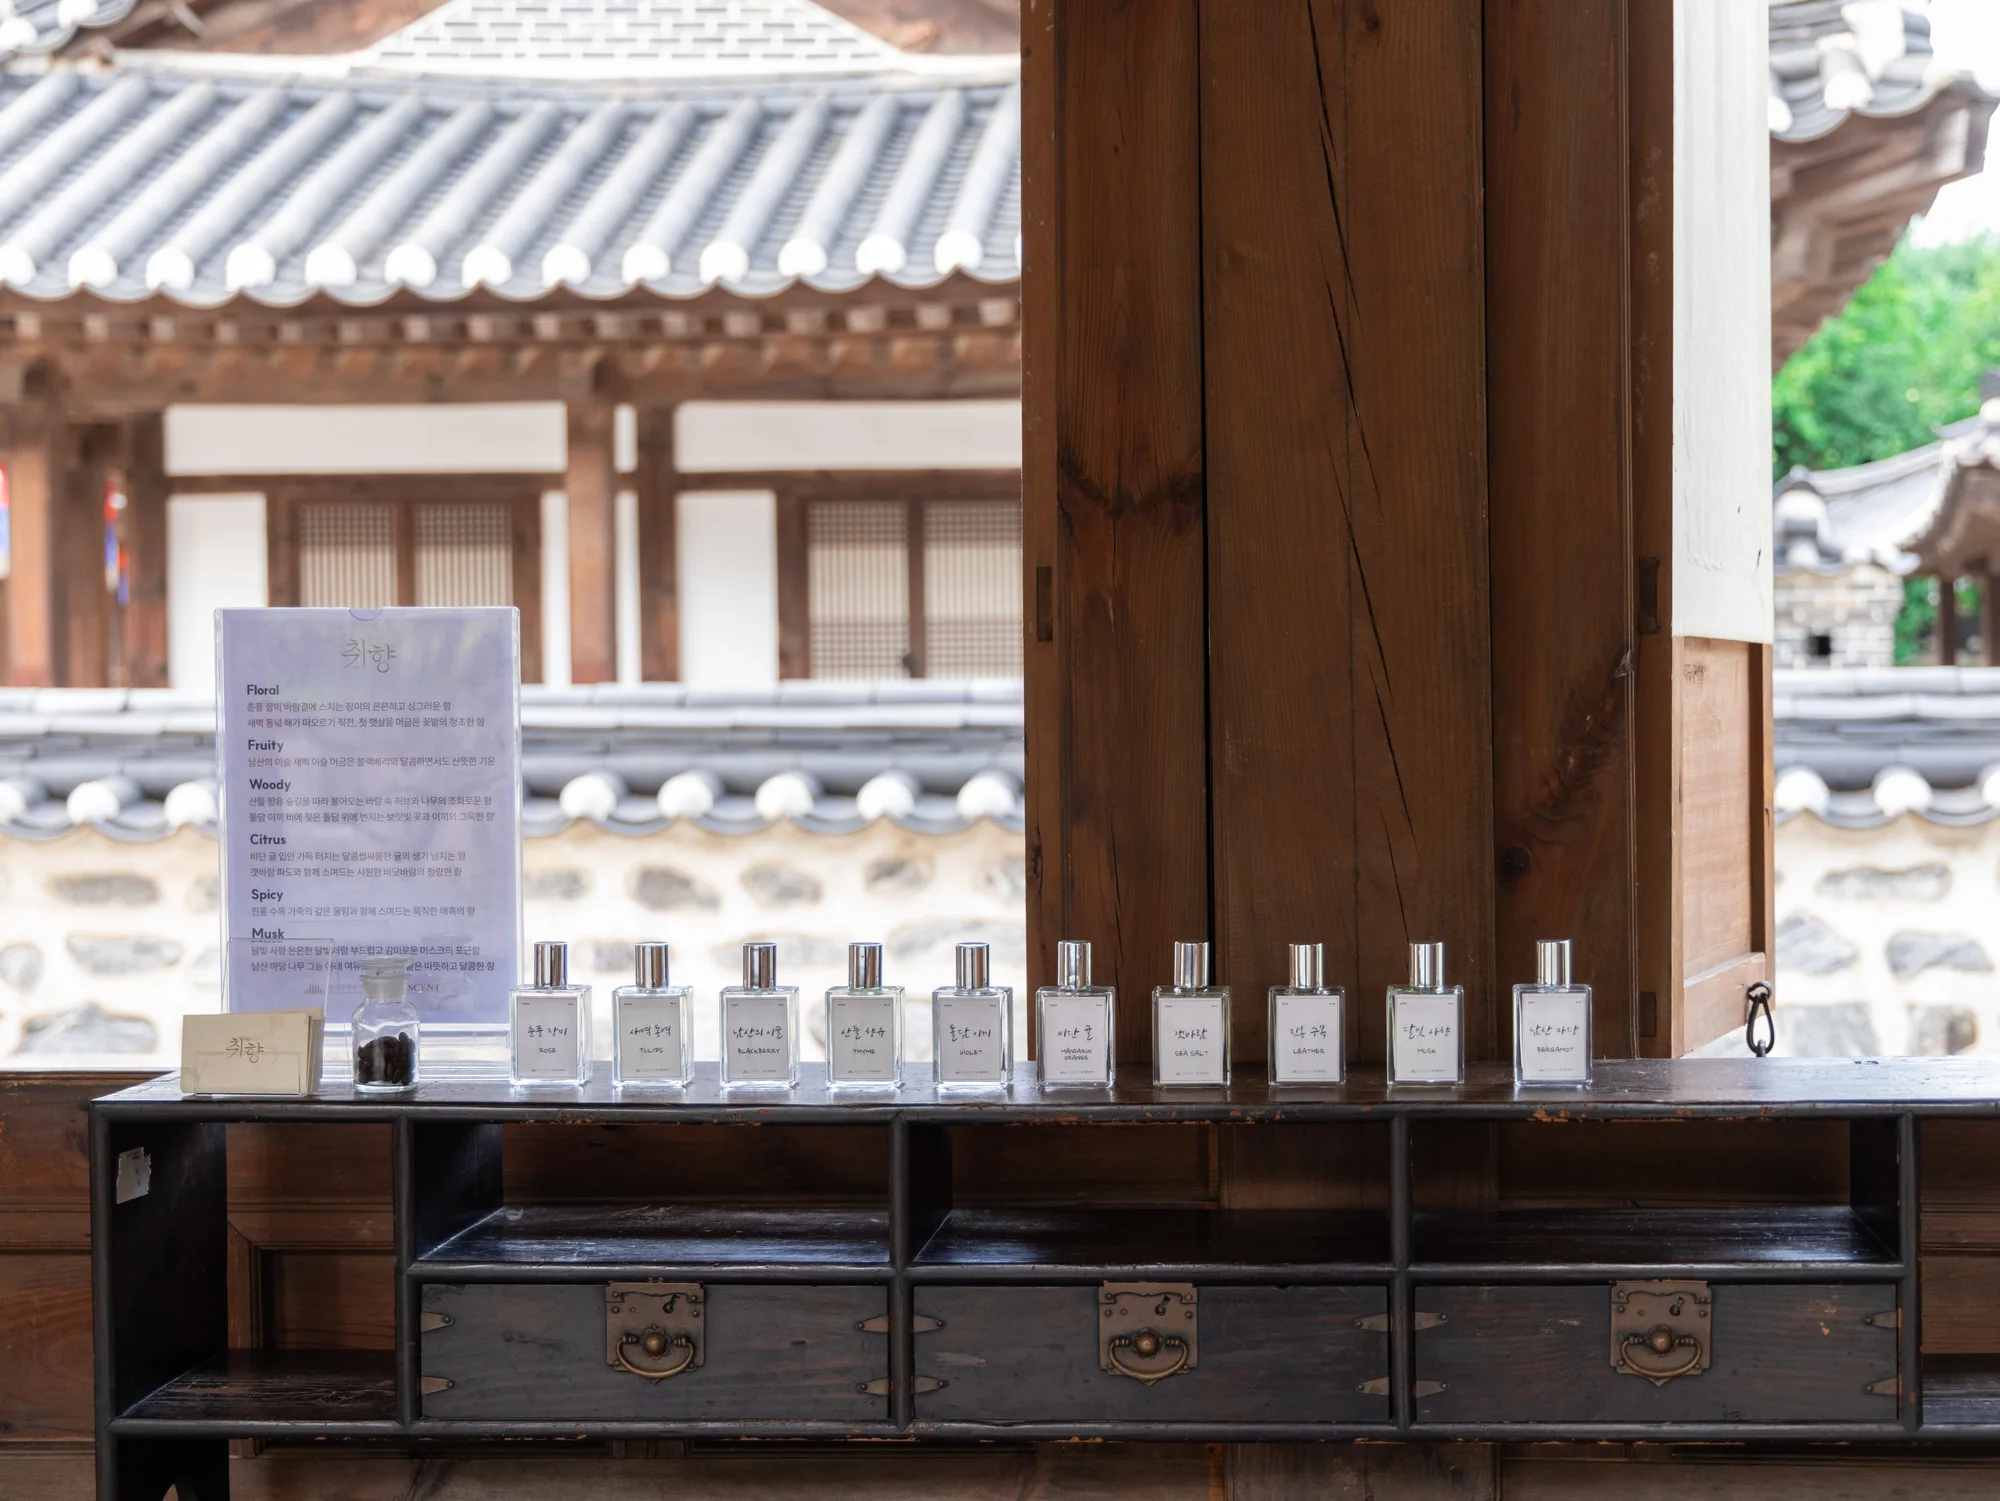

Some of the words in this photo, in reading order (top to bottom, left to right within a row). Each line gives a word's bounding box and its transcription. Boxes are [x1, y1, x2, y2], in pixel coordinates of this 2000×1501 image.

[341, 638, 397, 674] 취향
[246, 684, 280, 696] Floral
[265, 702, 282, 713] 장미
[283, 702, 317, 713] 바람결에
[319, 702, 344, 713] 스치는
[345, 702, 371, 713] 장미의
[372, 701, 406, 712] 은은하고
[407, 701, 441, 712] 싱그러운
[442, 701, 452, 712] 향
[247, 718, 264, 728] 새벽
[284, 718, 301, 728] 해가
[302, 718, 336, 728] 떠오르기
[359, 718, 367, 728] 첫
[369, 718, 394, 728] 햇살을
[395, 717, 420, 728] 머금은
[422, 717, 448, 728] 꽃밭의
[476, 717, 485, 728] 향
[247, 739, 284, 753] Fruity
[247, 757, 273, 768] 남산의
[293, 757, 310, 768] 새벽
[311, 757, 328, 768] 이슬
[330, 757, 355, 768] 머금은
[356, 757, 398, 768] 블랙베리의
[400, 756, 451, 767] 달콤하면서도
[452, 756, 477, 767] 산뜻한
[479, 756, 496, 767] 기운
[249, 778, 292, 793] Woody
[249, 797, 266, 807] 산들
[267, 797, 284, 807] 향유
[312, 797, 329, 807] 따라
[331, 797, 364, 807] 불어오는
[365, 797, 383, 807] 바람
[384, 796, 392, 806] 속
[394, 796, 419, 806] 허브와
[421, 796, 446, 806] 나무의
[448, 796, 482, 806] 조화로운
[484, 796, 492, 806] 향
[268, 812, 284, 823] 이끼
[286, 812, 303, 823] 비에
[304, 812, 321, 823] 젖은
[323, 812, 340, 823] 돌담
[341, 812, 358, 823] 위에
[359, 812, 386, 823] 번지는
[413, 812, 430, 822] 꽃과
[431, 812, 457, 822] 이끼의
[459, 812, 484, 822] 그윽한
[486, 812, 494, 822] 향
[249, 833, 287, 845] Citrus
[250, 852, 266, 862] 비단
[279, 852, 295, 862] 입안
[297, 852, 314, 862] 가득
[315, 852, 340, 862] 터지는
[393, 852, 410, 861] 귤의
[411, 852, 429, 861] 생기
[431, 852, 456, 861] 넘치는
[250, 867, 275, 877] 갯바람
[277, 867, 302, 877] 파도와
[304, 867, 320, 877] 함께
[322, 867, 355, 877] 스며드는
[357, 867, 381, 877] 시원한
[383, 867, 425, 877] 바닷바람의
[454, 867, 462, 877] 향
[251, 888, 284, 903] Spicy
[288, 907, 313, 917] 가죽의
[314, 907, 331, 917] 깊은
[333, 907, 357, 917] 울림과
[359, 907, 377, 917] 함께
[378, 906, 411, 916] 스며드는
[413, 906, 438, 916] 묵직한
[466, 906, 475, 916] 향
[252, 928, 285, 939] Musk
[251, 946, 268, 956] 달빛
[269, 946, 286, 956] 사향
[288, 946, 313, 956] 은은한
[314, 946, 349, 956] 달빛처럼
[350, 946, 383, 956] 부드럽고
[385, 946, 419, 956] 감미로운
[420, 946, 453, 956] 머스크의
[251, 962, 268, 972] 남산
[270, 962, 286, 972] 마당
[288, 962, 305, 972] 나무
[306, 962, 323, 972] 그늘
[325, 962, 343, 972] 아래
[424, 961, 457, 972] 따뜻하고
[459, 961, 484, 972] 달콤한
[486, 961, 495, 972] 향
[733, 1026, 764, 1039] 남산의
[841, 1024, 862, 1040] 산들
[865, 1027, 886, 1038] 향유
[949, 1024, 970, 1042] 돌담
[1057, 1027, 1080, 1039] 비단
[1084, 1024, 1093, 1041] 귤
[1174, 1027, 1208, 1040] 갯바람
[1428, 1026, 1451, 1037] 사향
[1529, 1024, 1553, 1036] 남산
[1555, 1025, 1580, 1036] 마당
[225, 1036, 265, 1064] 취향
[737, 1047, 781, 1055] BLACKBERRY
